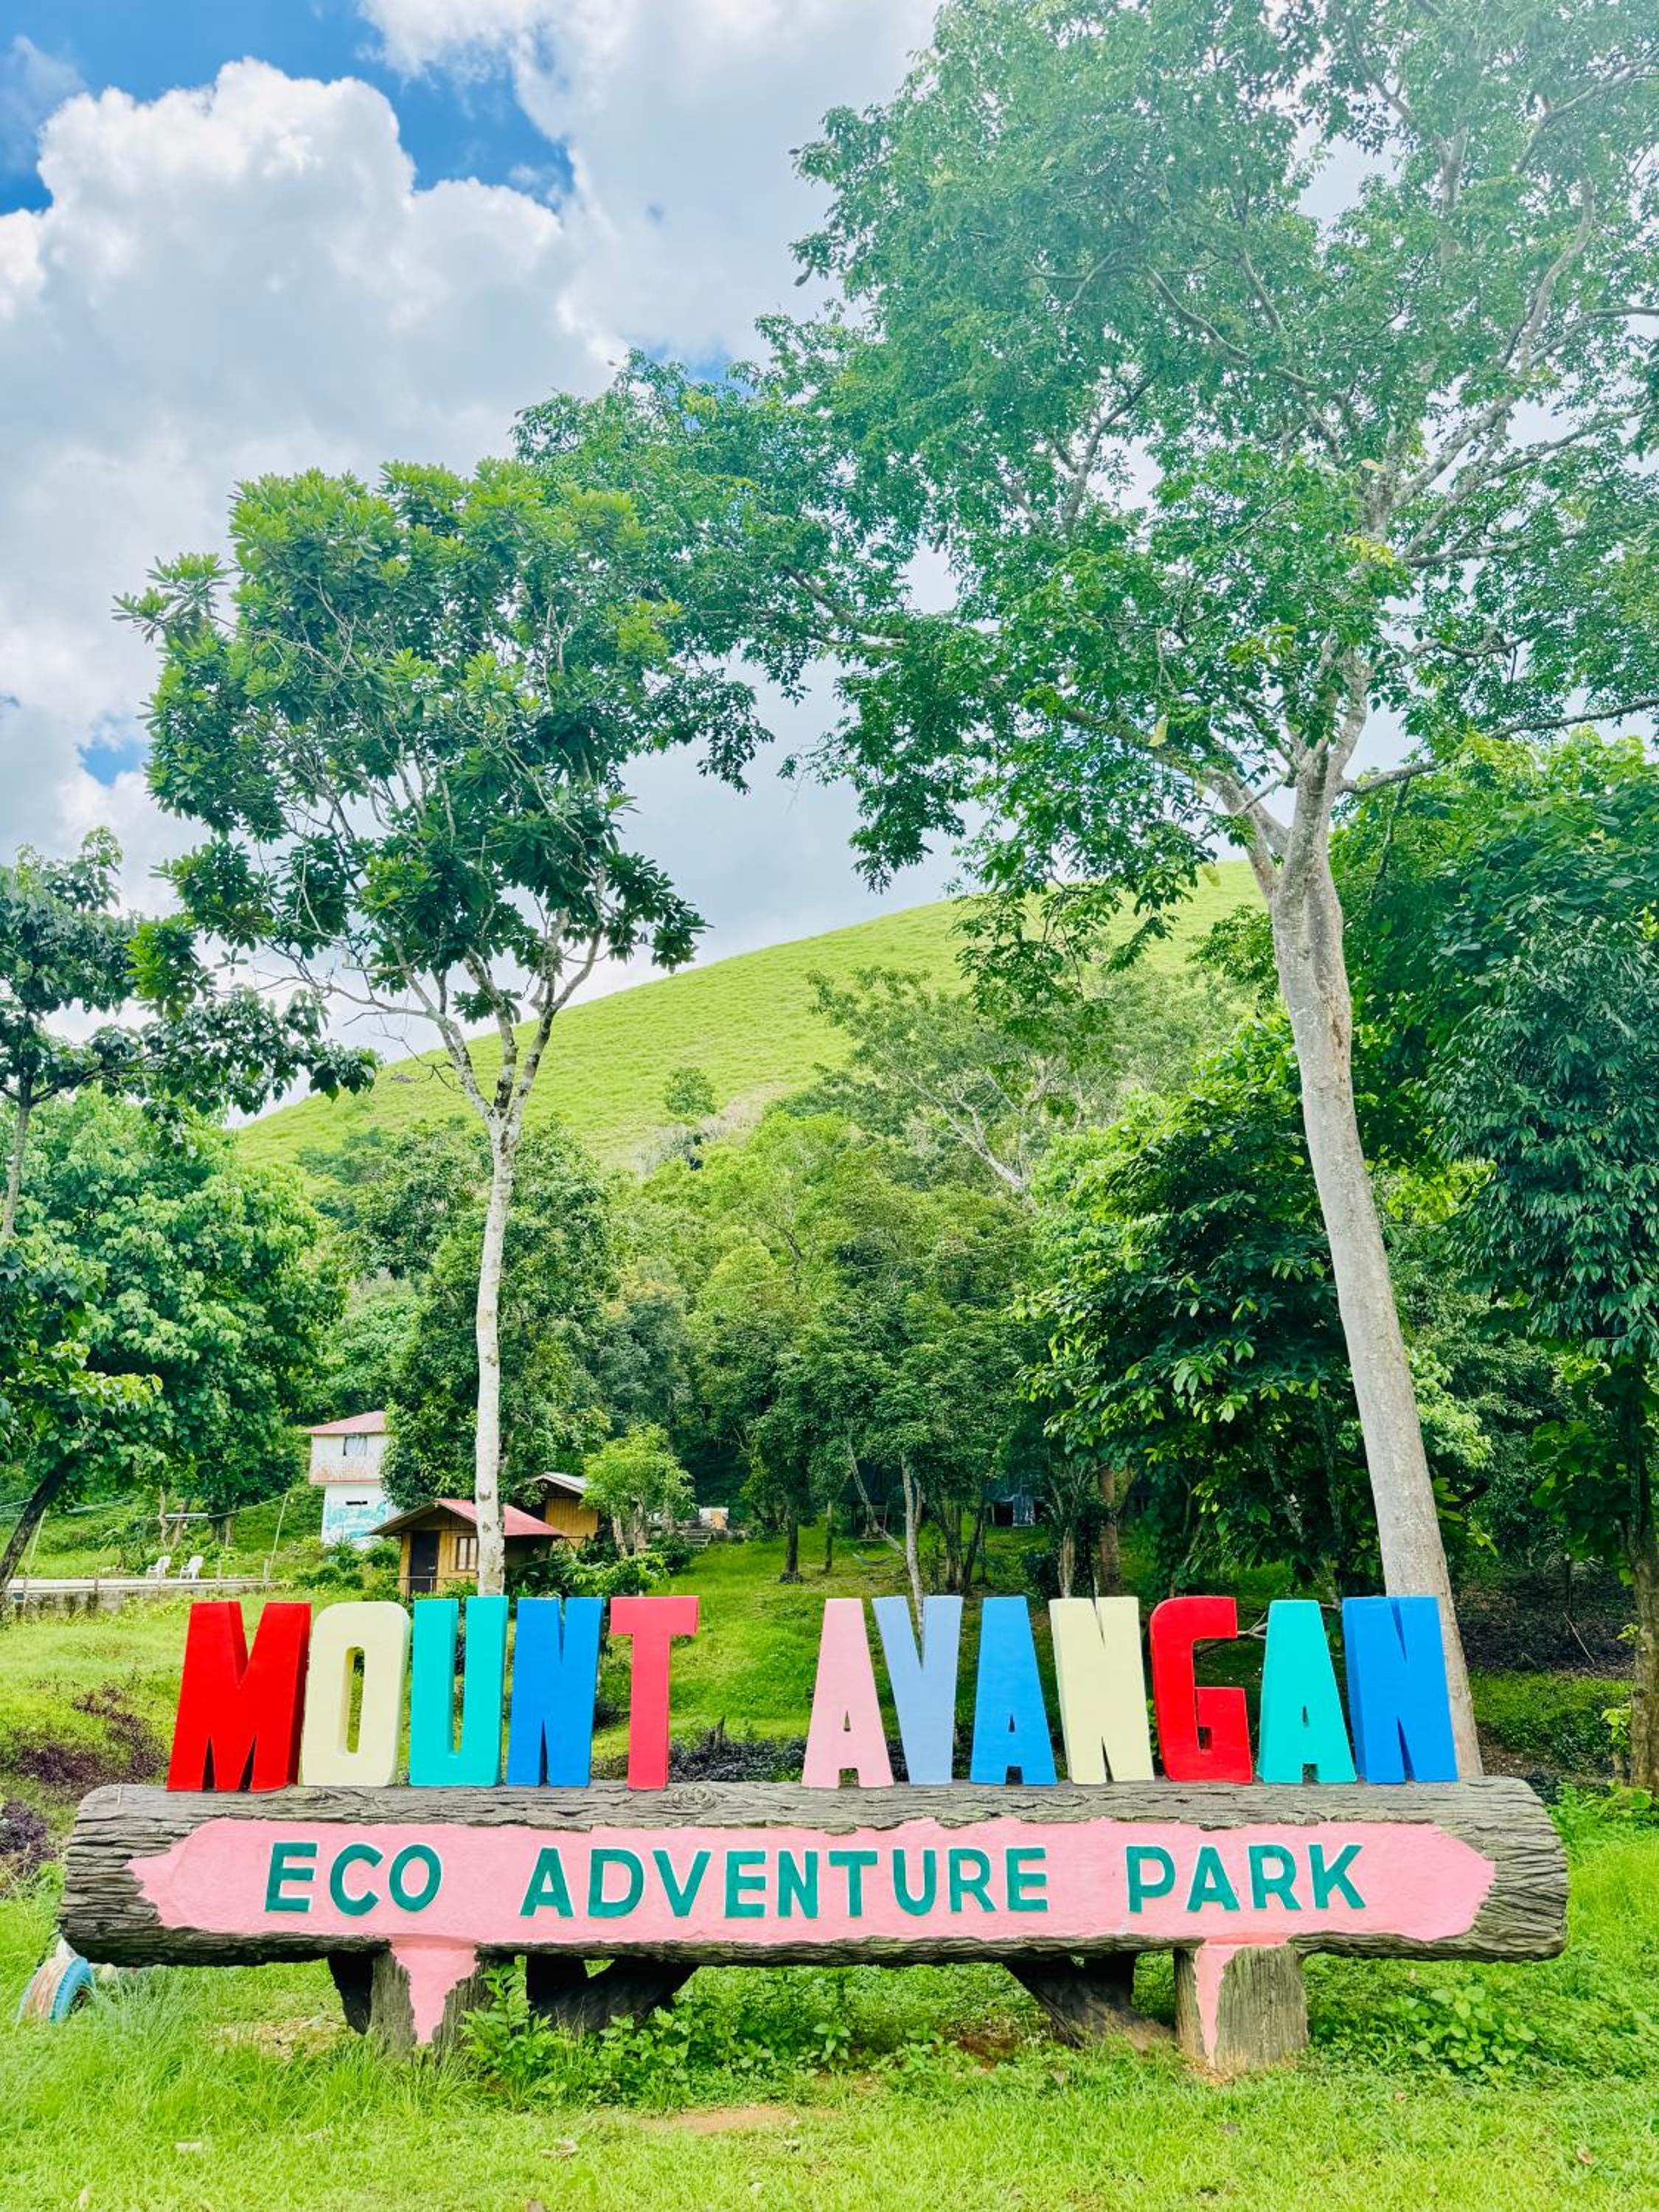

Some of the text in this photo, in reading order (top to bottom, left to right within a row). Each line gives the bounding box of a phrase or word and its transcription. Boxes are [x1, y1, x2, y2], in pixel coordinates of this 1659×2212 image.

[167, 1595, 1458, 1792] MOUNT AVANGAN
[264, 1840, 1367, 1918] ECO ADVENTURE PARK
